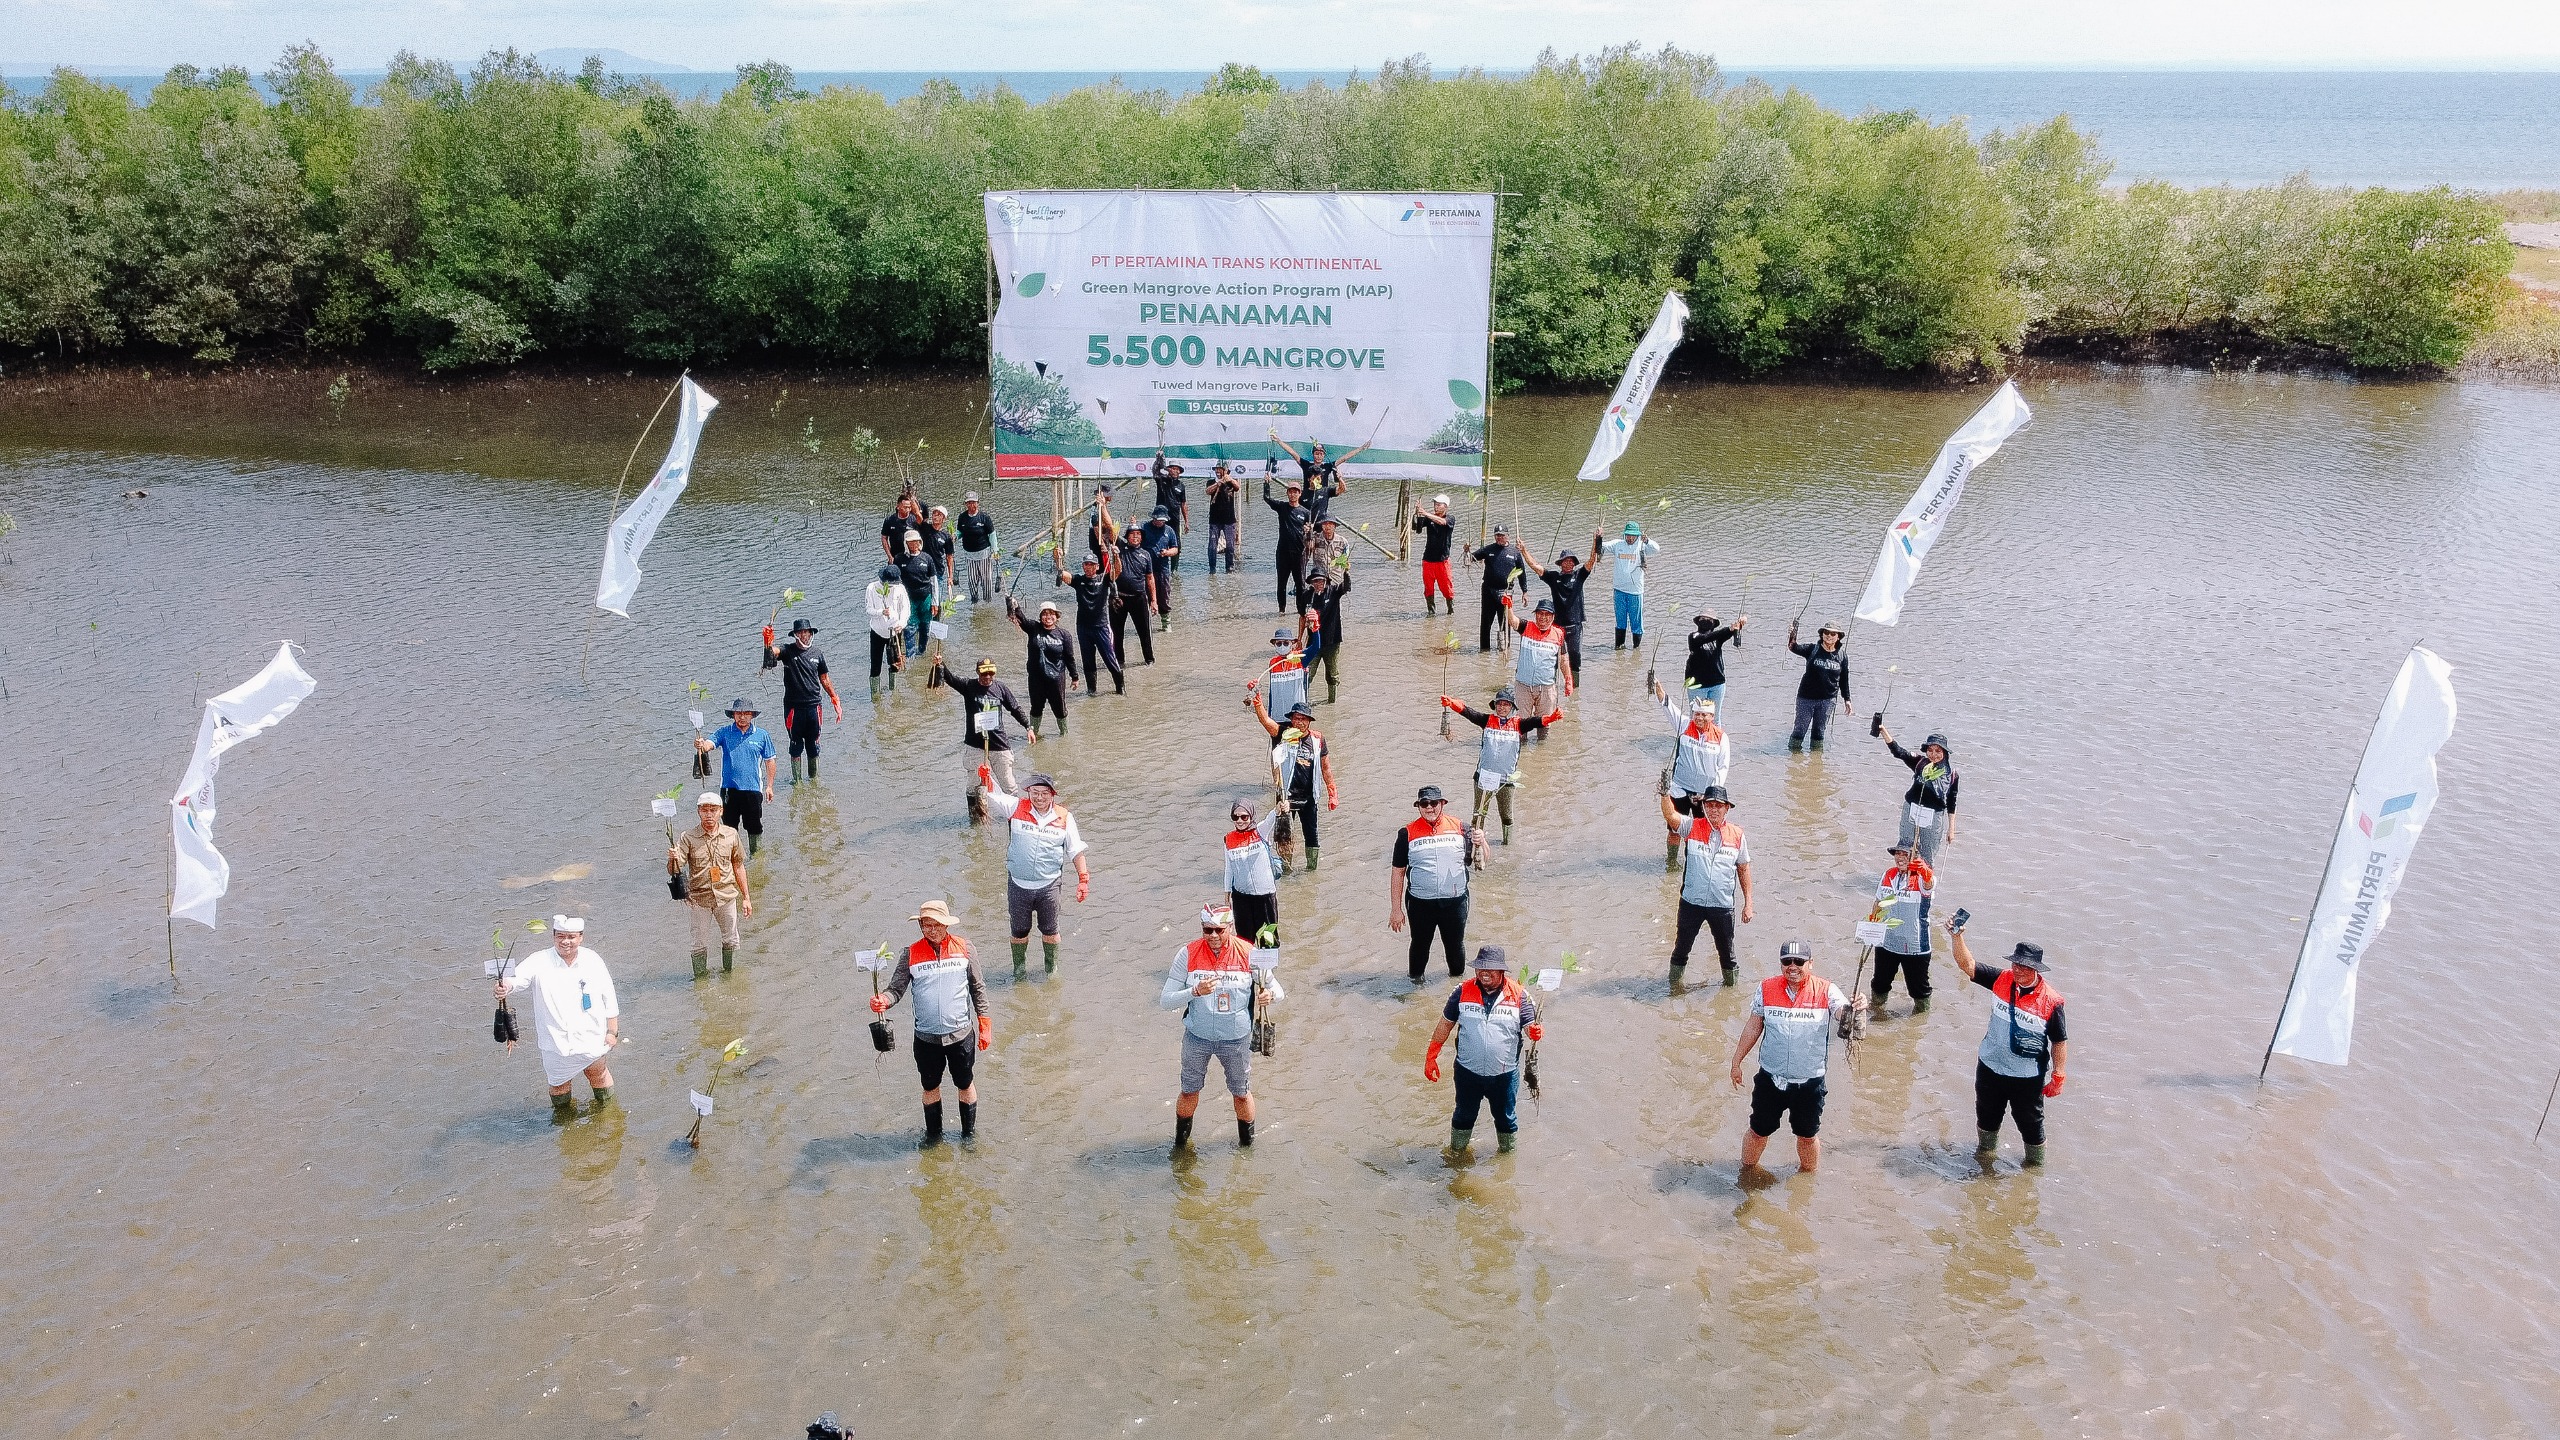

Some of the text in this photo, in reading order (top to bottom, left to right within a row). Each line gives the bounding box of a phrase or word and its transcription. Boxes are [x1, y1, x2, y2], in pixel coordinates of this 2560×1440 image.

[1429, 209, 1481, 217] PERTAMINA
[1091, 255, 1382, 270] PT PERTAMINA TRANS KONTINENTAL
[1081, 281, 1393, 299] Green Mangrove Action Program (MAP)
[1140, 302, 1332, 326] PENANAMAN
[1086, 334, 1385, 369] 5.500 MANGROVE
[1626, 351, 1656, 403] PERTAMINA
[1151, 380, 1320, 393] Tuwed Mangrove Park, Bali
[1188, 402, 1200, 412] 19
[1203, 402, 1255, 413] Agustus
[1919, 453, 1966, 521] PERTAMINA
[917, 961, 962, 972] PERTAMINA
[1767, 1008, 1815, 1020] PERTAMINA
